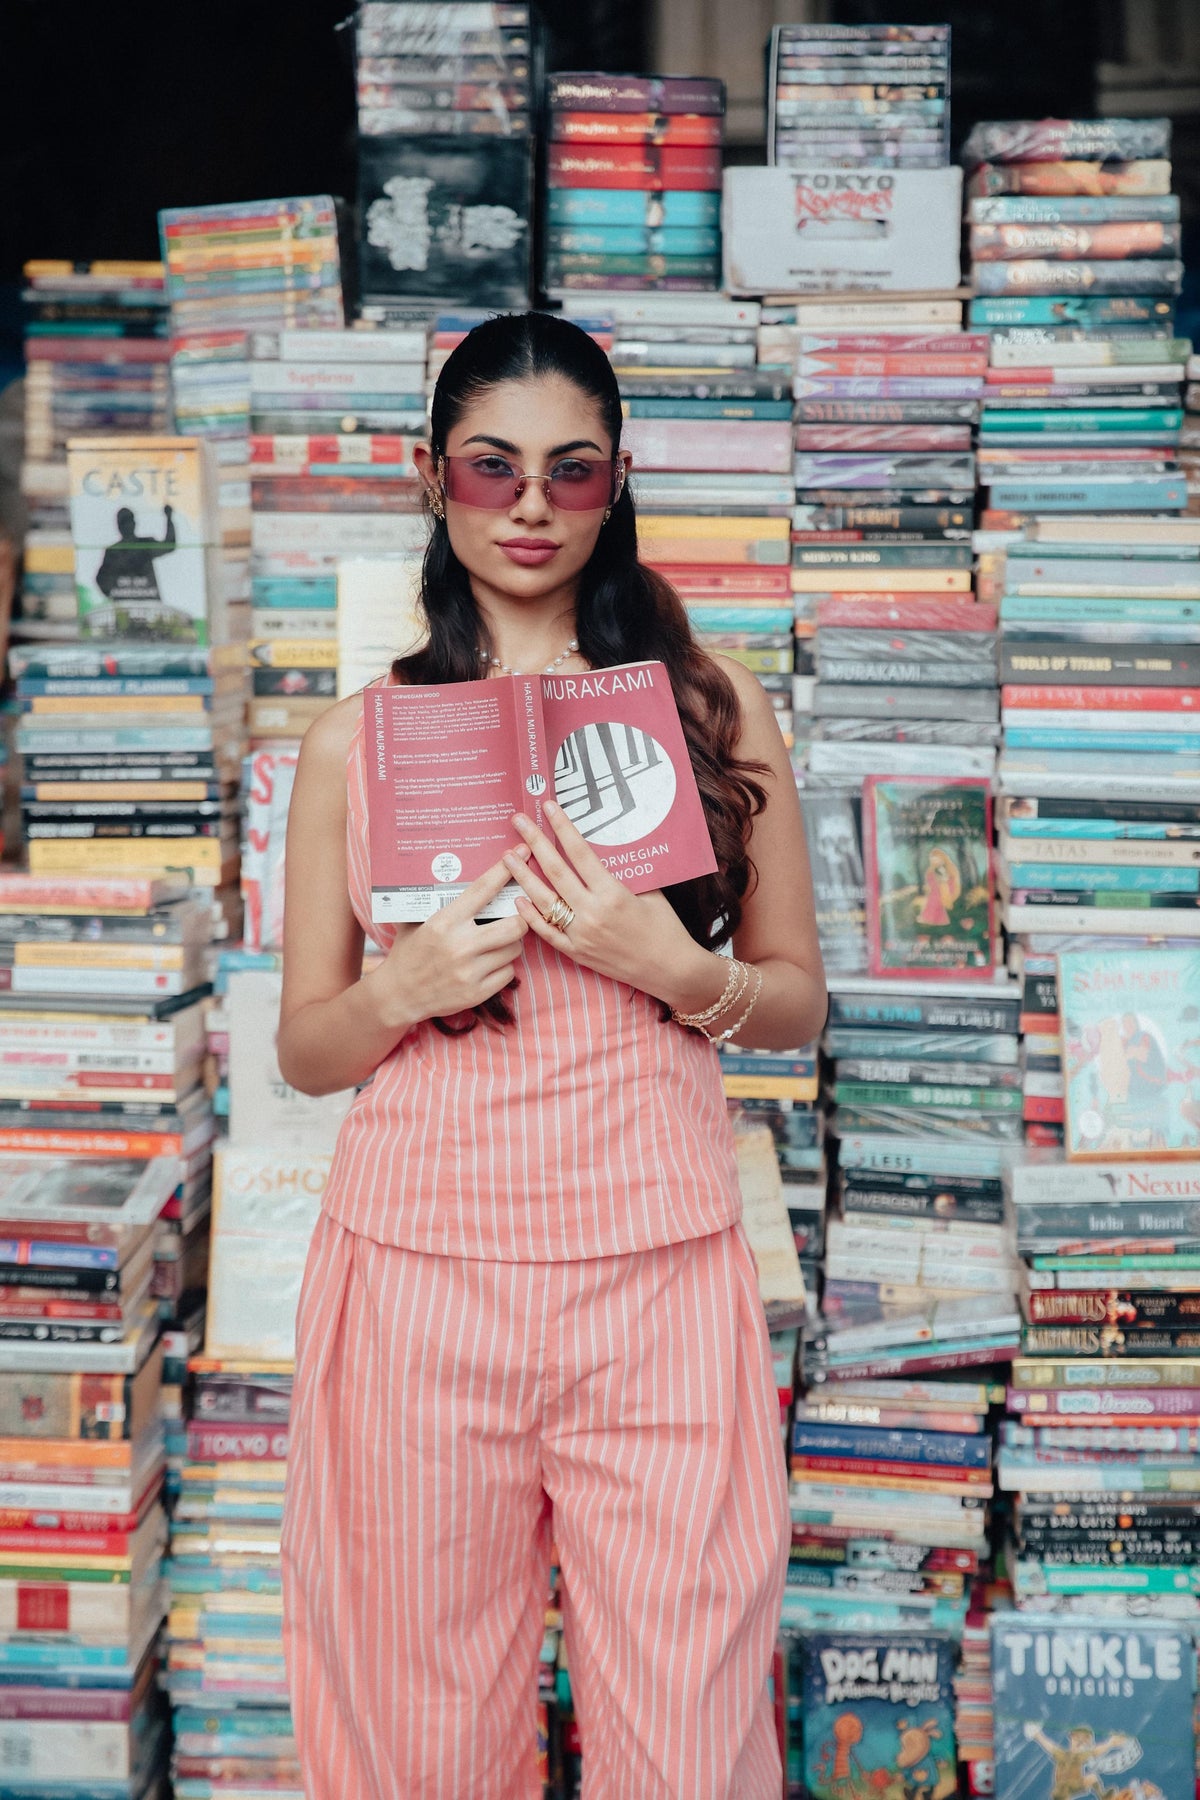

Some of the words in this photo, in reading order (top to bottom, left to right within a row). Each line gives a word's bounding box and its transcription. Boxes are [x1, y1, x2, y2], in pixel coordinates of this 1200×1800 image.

[1069, 121, 1116, 138] MARK
[790, 174, 894, 190] TOKYO
[82, 468, 180, 497] CASTE
[827, 662, 921, 681] MURAKAMI
[1010, 655, 1049, 671] TOOLS
[1051, 655, 1067, 671] OF
[1069, 656, 1112, 671] TITANS
[543, 669, 655, 701] MURAKAMI
[524, 682, 533, 717] HARUKI
[373, 694, 384, 728] HARUKI
[376, 729, 387, 782] MURAKAMI
[527, 719, 539, 771] MURAKAMI
[535, 799, 544, 831] NORWEG
[600, 842, 670, 870] ORWEGIAN
[1035, 843, 1088, 858] TATAS
[612, 863, 655, 881] WOOD
[911, 1087, 931, 1104] 90
[933, 1088, 973, 1106] DAYS
[871, 1155, 913, 1169] LESS
[229, 1166, 328, 1196] OSHO
[1127, 1172, 1200, 1197] Nexus
[846, 1189, 930, 1212] DIVERGENT
[1089, 1213, 1124, 1232] India
[202, 1432, 269, 1457] TOKYO
[271, 1433, 288, 1457] G
[924, 1446, 965, 1461] GANG
[1081, 1491, 1119, 1504] GUYS
[1119, 1503, 1148, 1516] GUYS
[1049, 1516, 1079, 1529] BAD
[1079, 1516, 1117, 1529] GUYS
[1044, 1551, 1073, 1564] BAD
[1073, 1551, 1111, 1564] GUYS
[820, 1648, 880, 1684] DOG
[881, 1648, 938, 1684] MAN
[1002, 1632, 1183, 1681] TINKLE
[1045, 1677, 1135, 1698] ORIGINS
